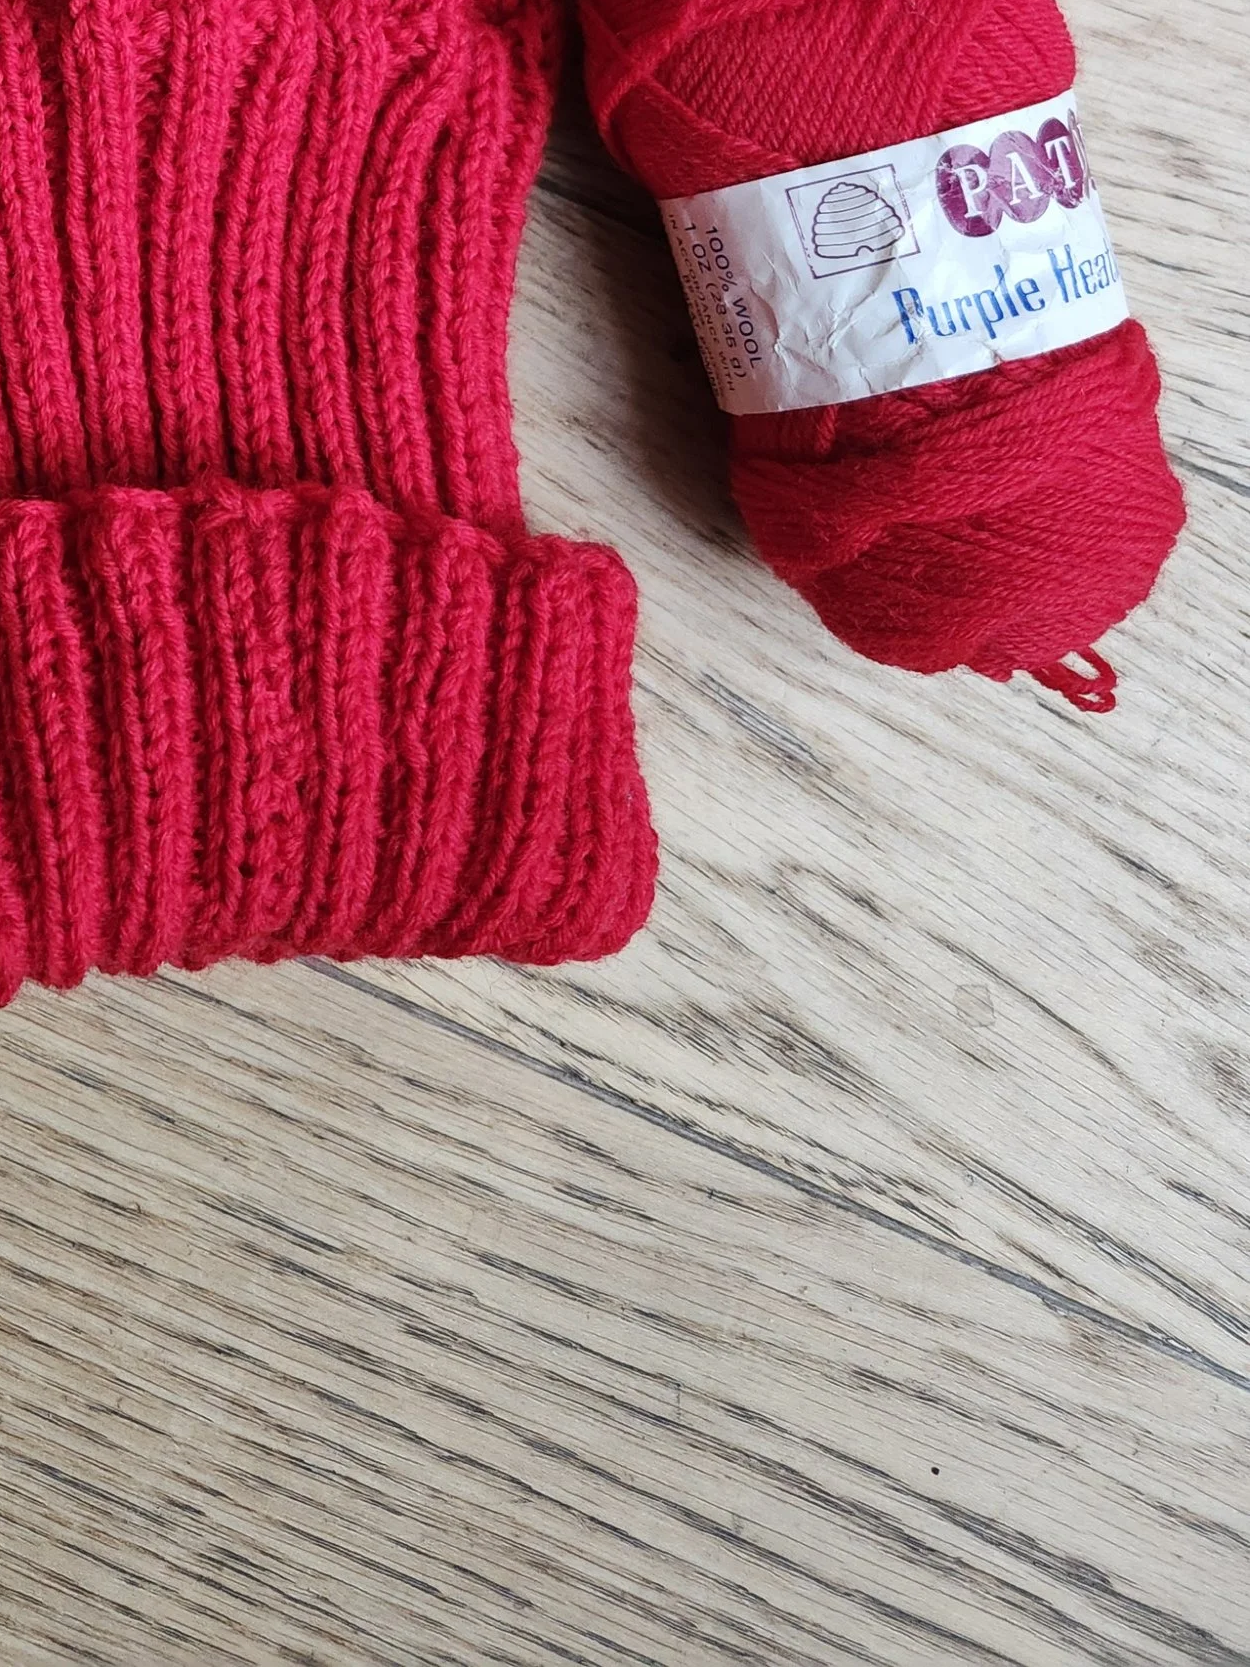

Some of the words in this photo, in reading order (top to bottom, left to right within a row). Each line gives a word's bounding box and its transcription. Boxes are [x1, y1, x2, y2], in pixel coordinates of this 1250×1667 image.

[692, 243, 712, 274] OZ
[705, 226, 738, 293] 100%
[732, 297, 762, 369] WOOL
[892, 265, 1046, 345] Purple
